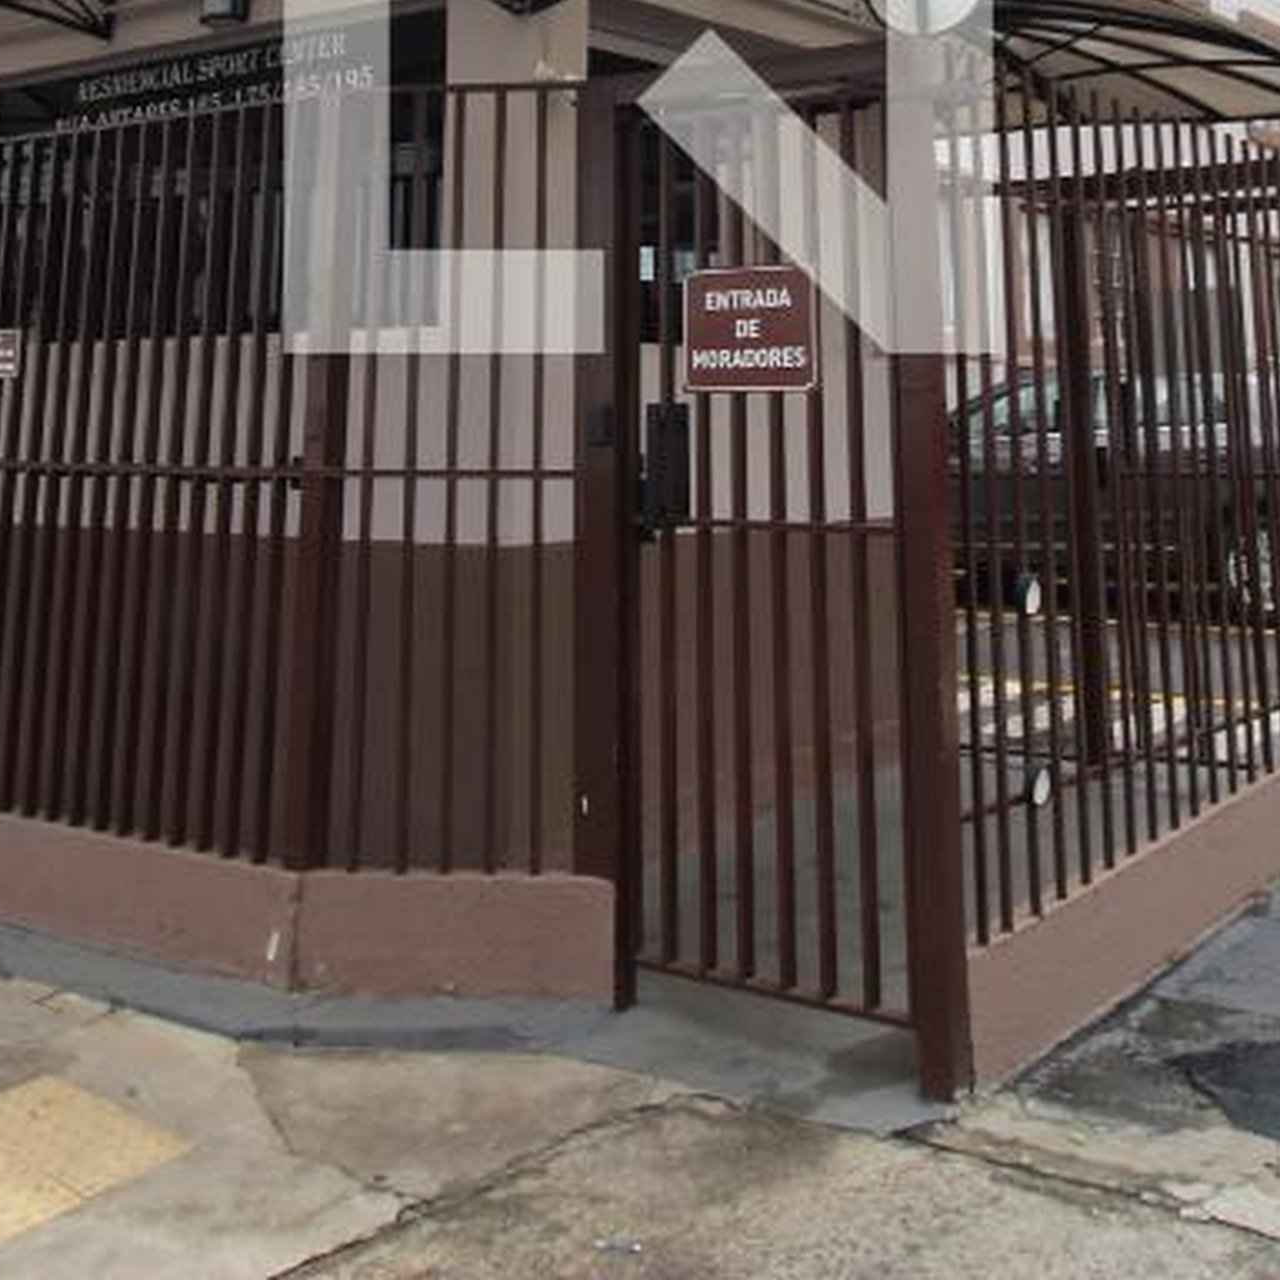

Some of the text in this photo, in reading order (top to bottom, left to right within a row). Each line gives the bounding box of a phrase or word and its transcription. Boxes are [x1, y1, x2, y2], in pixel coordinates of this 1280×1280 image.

[196, 48, 264, 81] SPORT
[704, 287, 792, 311] ENTRADA
[734, 319, 761, 339] DE
[692, 345, 805, 369] MORADORES
